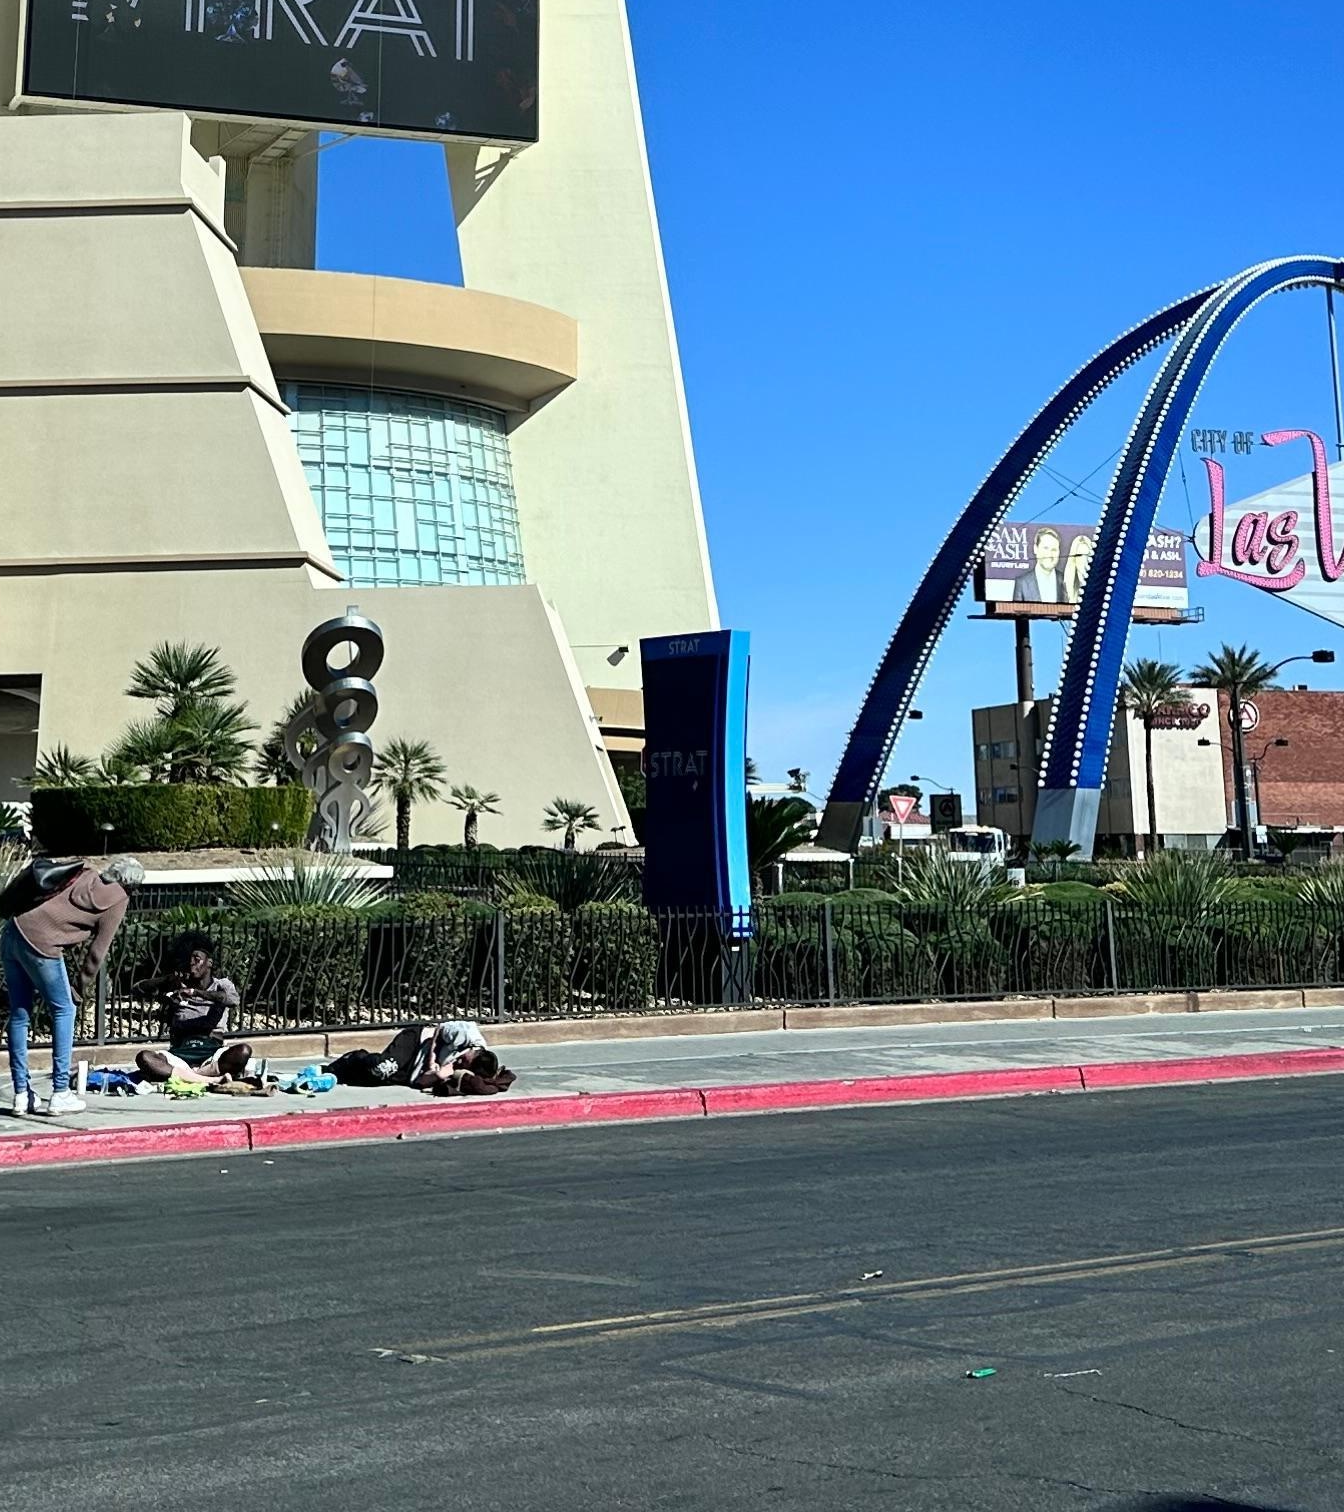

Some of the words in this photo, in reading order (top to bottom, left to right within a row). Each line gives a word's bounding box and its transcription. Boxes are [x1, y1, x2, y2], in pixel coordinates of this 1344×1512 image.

[1191, 428, 1227, 455] CITY
[1232, 431, 1255, 456] OF
[1195, 456, 1306, 594] Las
[993, 543, 1029, 561] ASH
[667, 638, 701, 656] STRAT
[650, 750, 709, 779] STRAT
